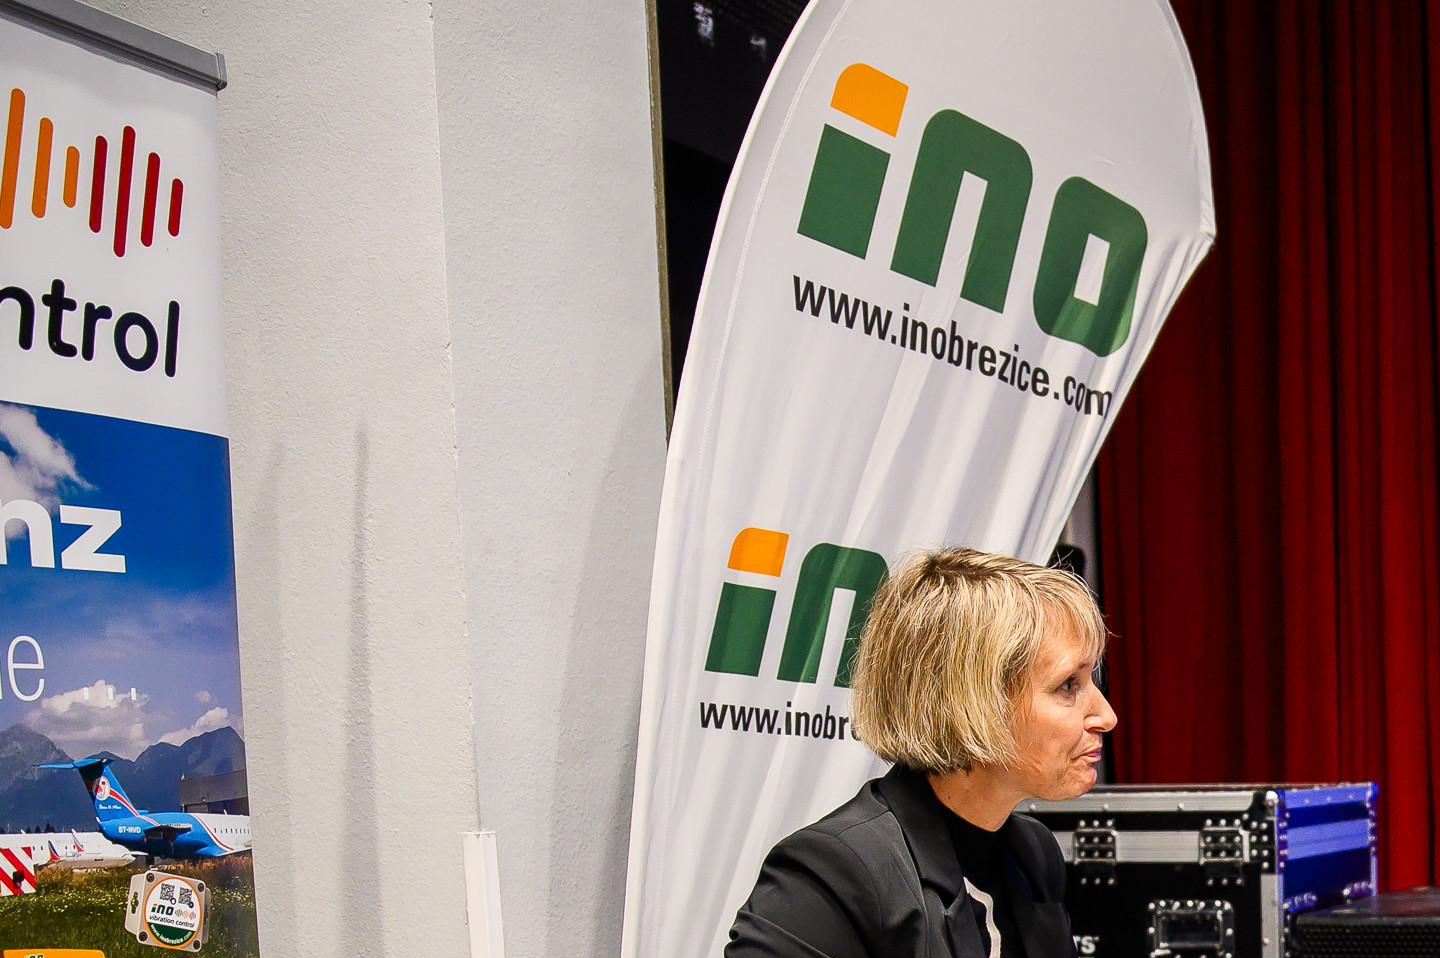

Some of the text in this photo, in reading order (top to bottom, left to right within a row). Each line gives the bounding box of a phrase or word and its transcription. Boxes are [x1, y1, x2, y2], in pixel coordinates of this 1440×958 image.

[797, 62, 1148, 358] ino
[793, 275, 1113, 419] www.inobrezice.com
[0, 634, 45, 701] e
[151, 903, 174, 916] ino
